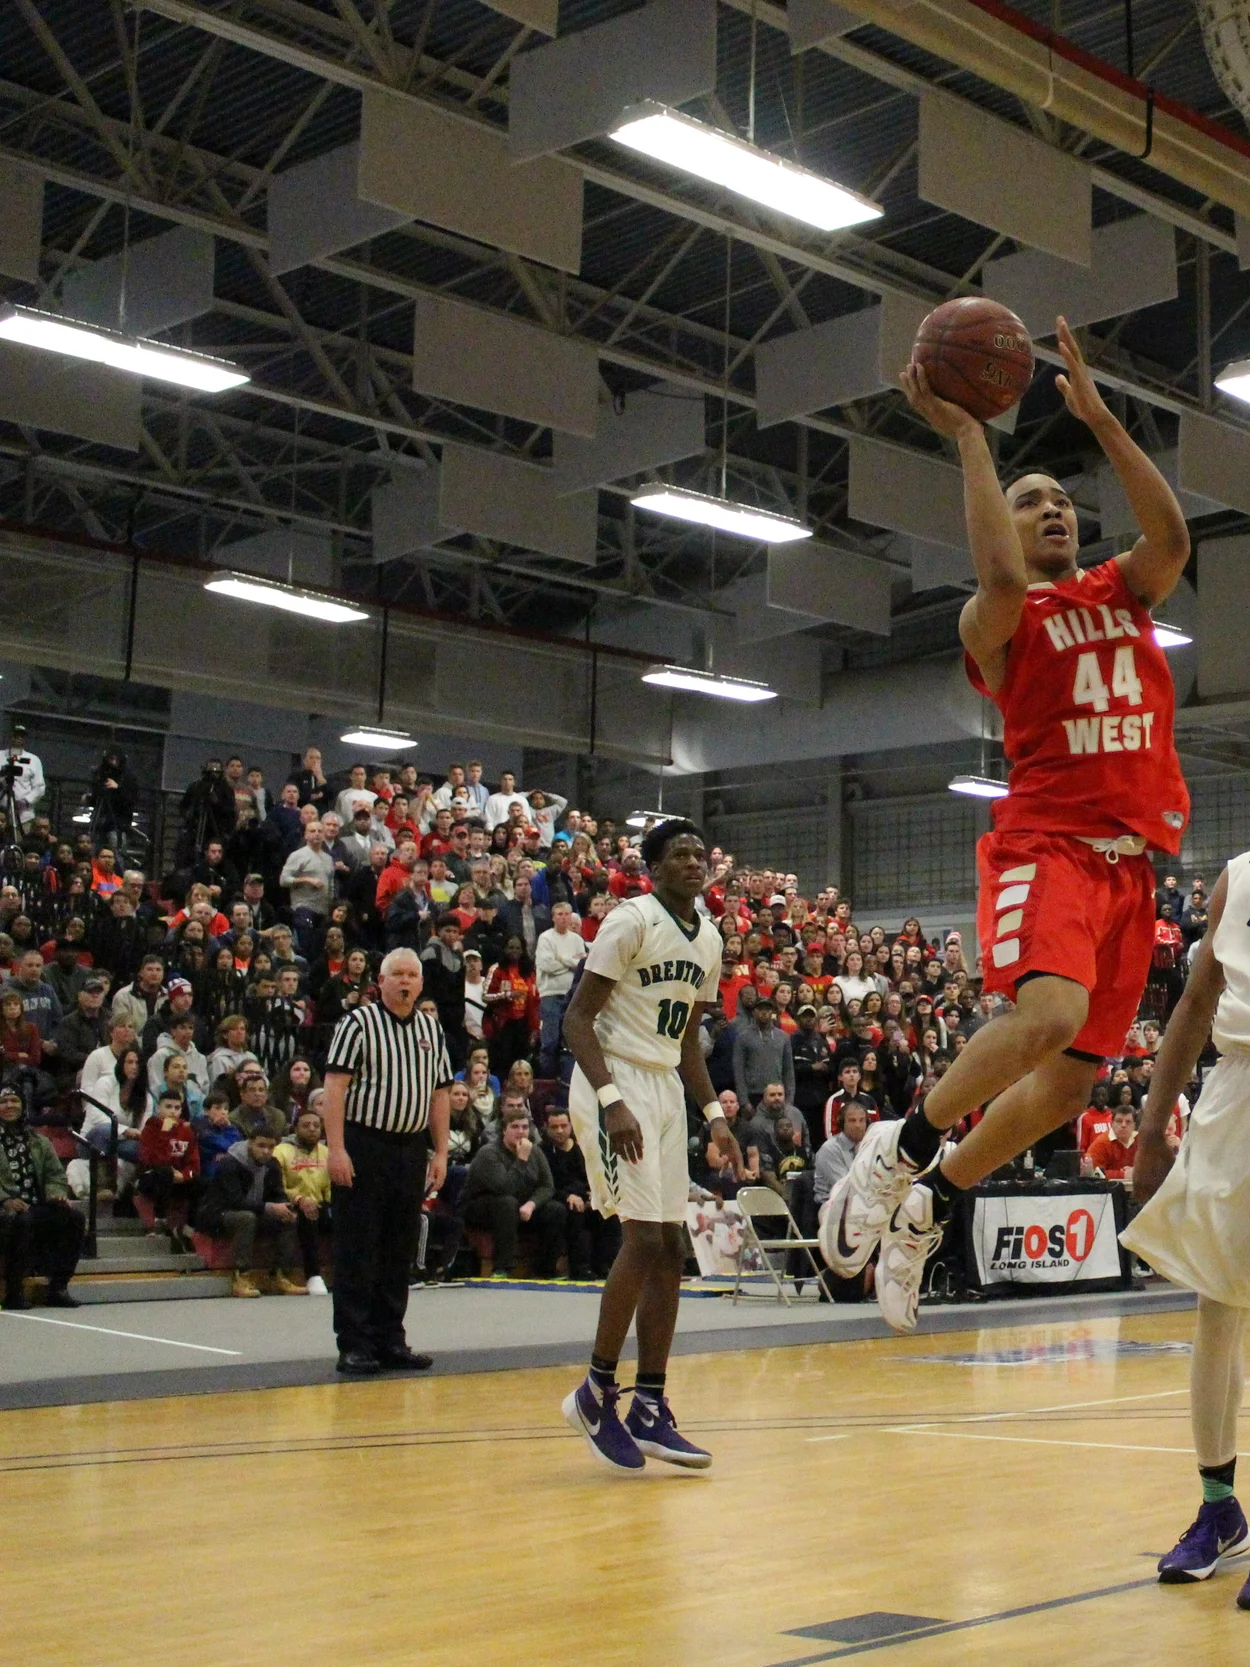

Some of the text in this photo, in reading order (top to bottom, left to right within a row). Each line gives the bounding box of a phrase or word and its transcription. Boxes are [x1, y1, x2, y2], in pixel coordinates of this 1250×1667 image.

[1042, 604, 1141, 652] HILLS
[1072, 645, 1143, 713] 44
[1062, 711, 1155, 755] WEST
[656, 998, 689, 1040] 10
[990, 1258, 1070, 1270] LONG ISLAND
